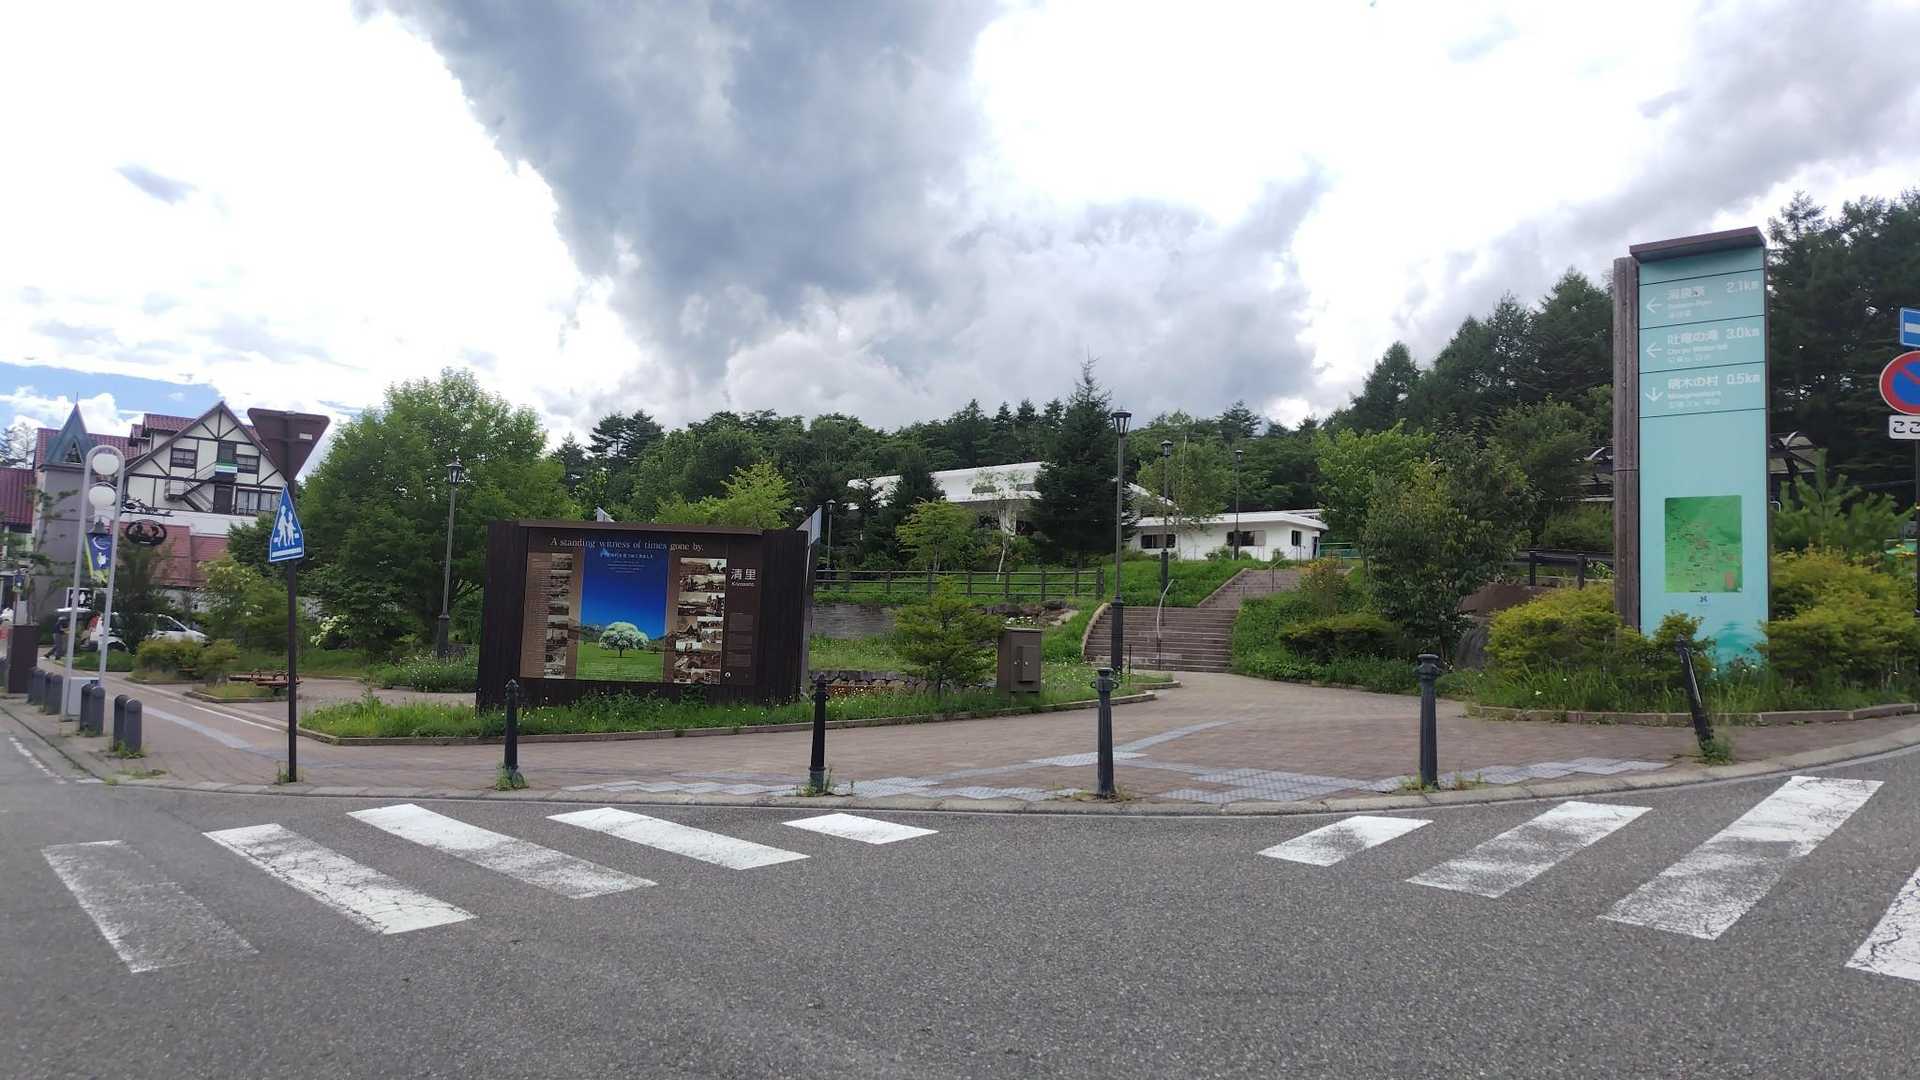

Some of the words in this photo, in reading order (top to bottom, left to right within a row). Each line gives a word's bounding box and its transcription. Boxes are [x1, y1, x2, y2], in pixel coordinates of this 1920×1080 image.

[550, 538, 558, 546] A
[559, 538, 596, 549] standing
[599, 539, 631, 549] witness
[632, 539, 641, 549] of
[644, 540, 667, 550] times
[670, 543, 690, 552] gone
[730, 568, 757, 580] 清里
